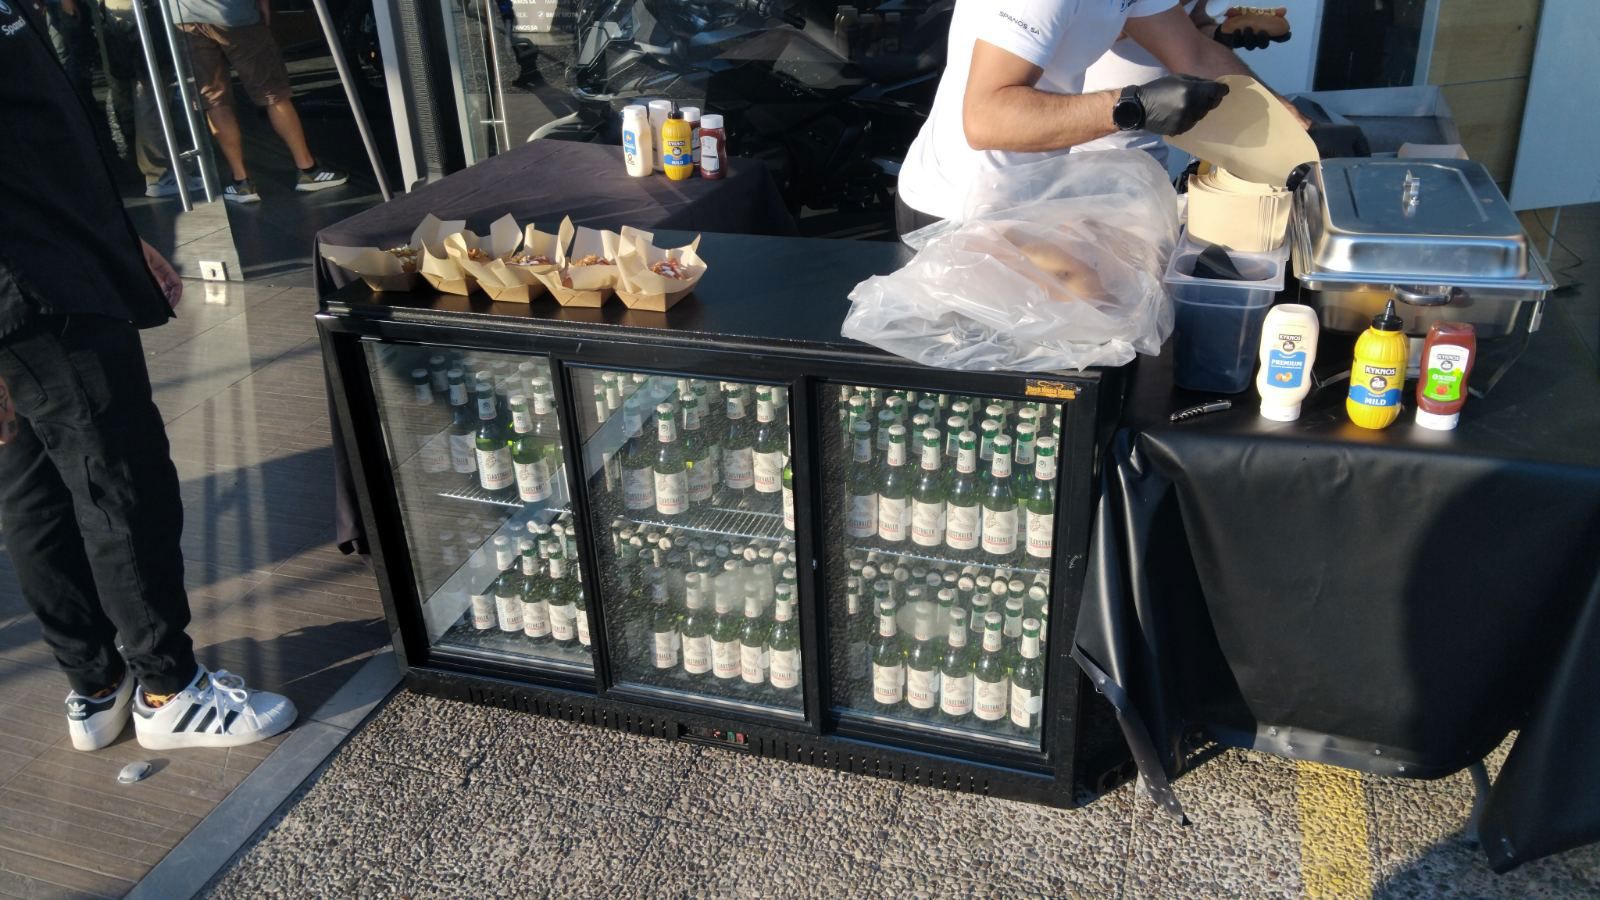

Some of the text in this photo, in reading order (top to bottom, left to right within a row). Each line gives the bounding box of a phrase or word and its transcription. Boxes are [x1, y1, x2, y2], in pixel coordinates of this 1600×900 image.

[1000, 11, 1028, 29] SPANOS
[1271, 359, 1302, 367] PREMIUM
[1365, 366, 1395, 375] KYKNOS
[1364, 397, 1387, 405] MILD
